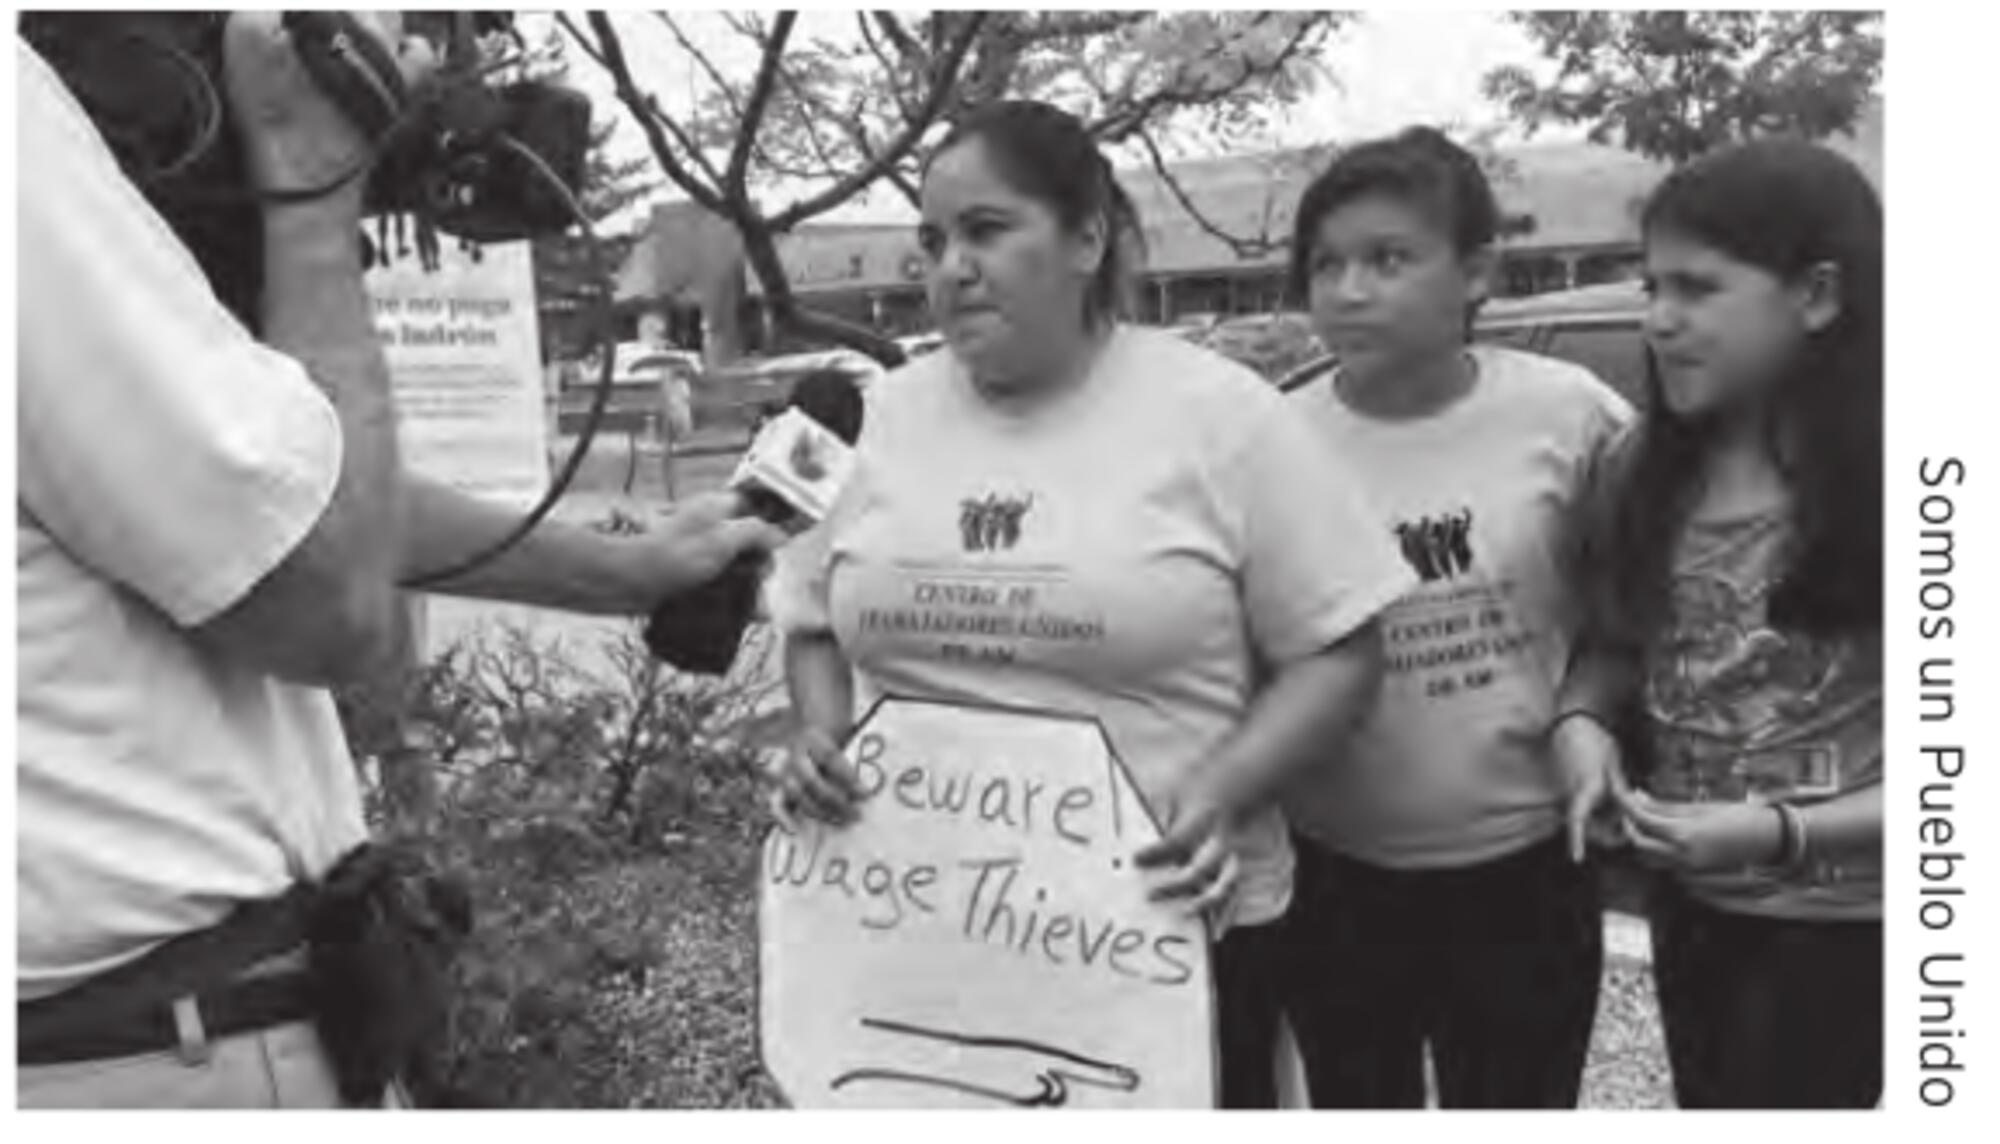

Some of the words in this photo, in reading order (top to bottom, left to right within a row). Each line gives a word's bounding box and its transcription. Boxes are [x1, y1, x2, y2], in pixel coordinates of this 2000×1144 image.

[406, 298, 442, 315] no
[449, 298, 512, 322] paga
[914, 580, 999, 604] CENTRO
[1007, 585, 1036, 606] DE
[858, 607, 1014, 636] TRABAJADORES
[1017, 611, 1107, 640] UNIDOS
[855, 732, 1122, 871] Beware!
[768, 824, 940, 931] Wage
[957, 856, 1196, 986] Thieves
